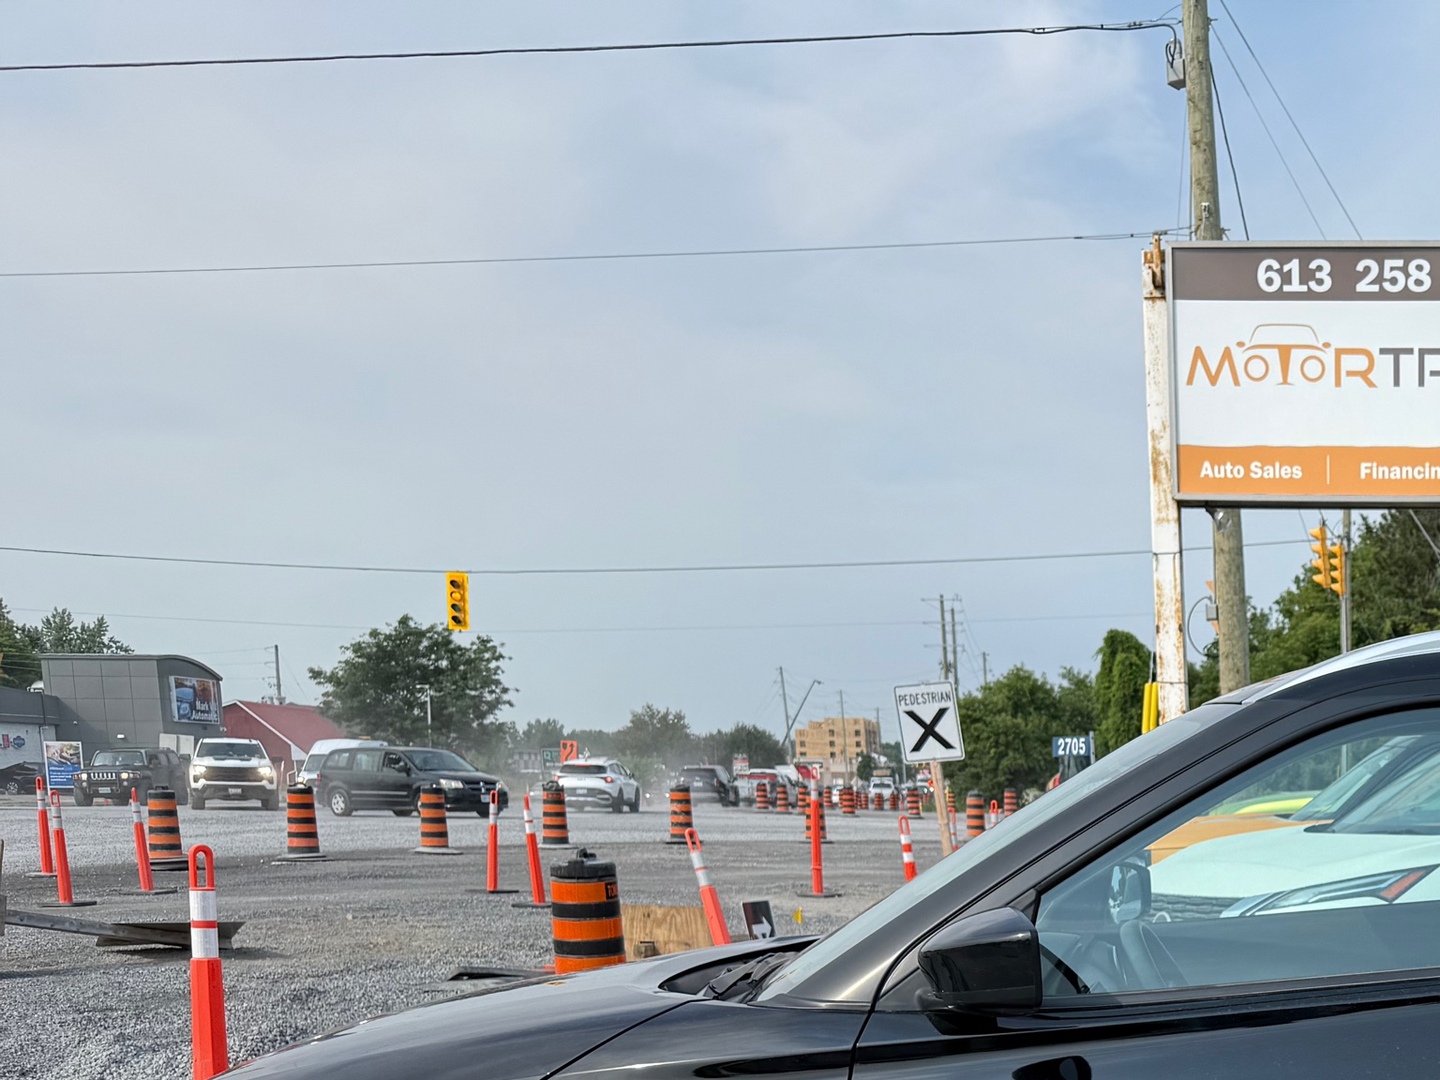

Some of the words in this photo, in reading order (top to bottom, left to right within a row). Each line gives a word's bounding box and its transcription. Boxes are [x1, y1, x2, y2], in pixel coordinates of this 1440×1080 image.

[1256, 258, 1333, 293] 613
[1355, 258, 1432, 293] 258
[1200, 461, 1245, 479] Auto
[1249, 461, 1303, 480] Sales
[898, 690, 952, 707] PEDESTRIAN
[1057, 737, 1086, 755] 2705
